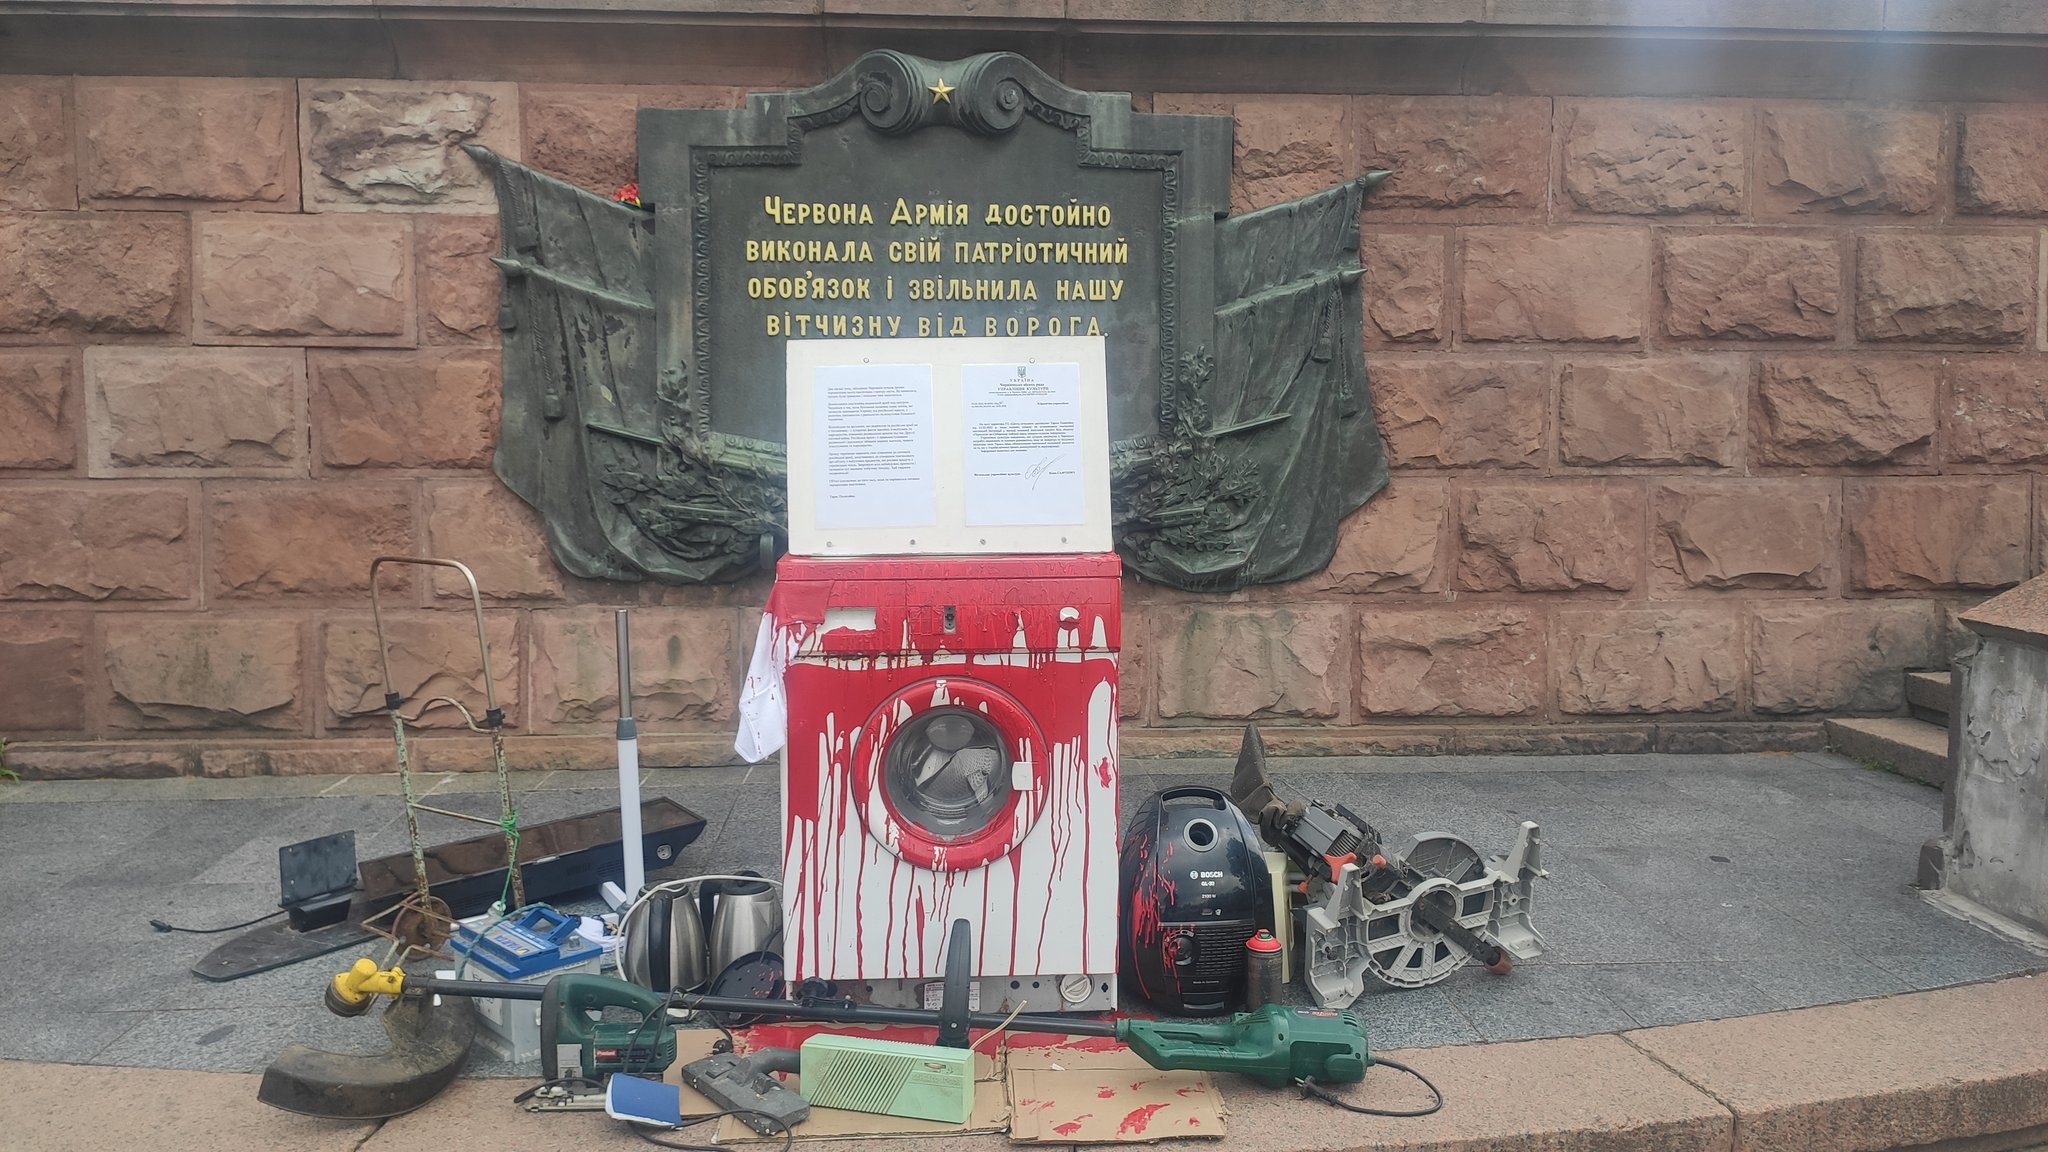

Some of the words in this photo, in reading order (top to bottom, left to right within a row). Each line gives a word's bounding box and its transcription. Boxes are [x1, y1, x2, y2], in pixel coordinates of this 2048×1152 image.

[985, 199, 1111, 226] ДОСТОЙНО
[746, 240, 873, 262] ВИКОНАЛА
[889, 236, 941, 263] СВІЙ
[954, 237, 1128, 264] ПАТРІОТИЧНИЙ
[747, 270, 870, 299] ОБОВ'ЯЗОК
[908, 274, 1038, 301] ЗВІЛЬНИЛА
[1056, 279, 1124, 301] НАШУ
[766, 312, 902, 337] ВІТЧИЗНУ
[918, 312, 966, 337] ВІД
